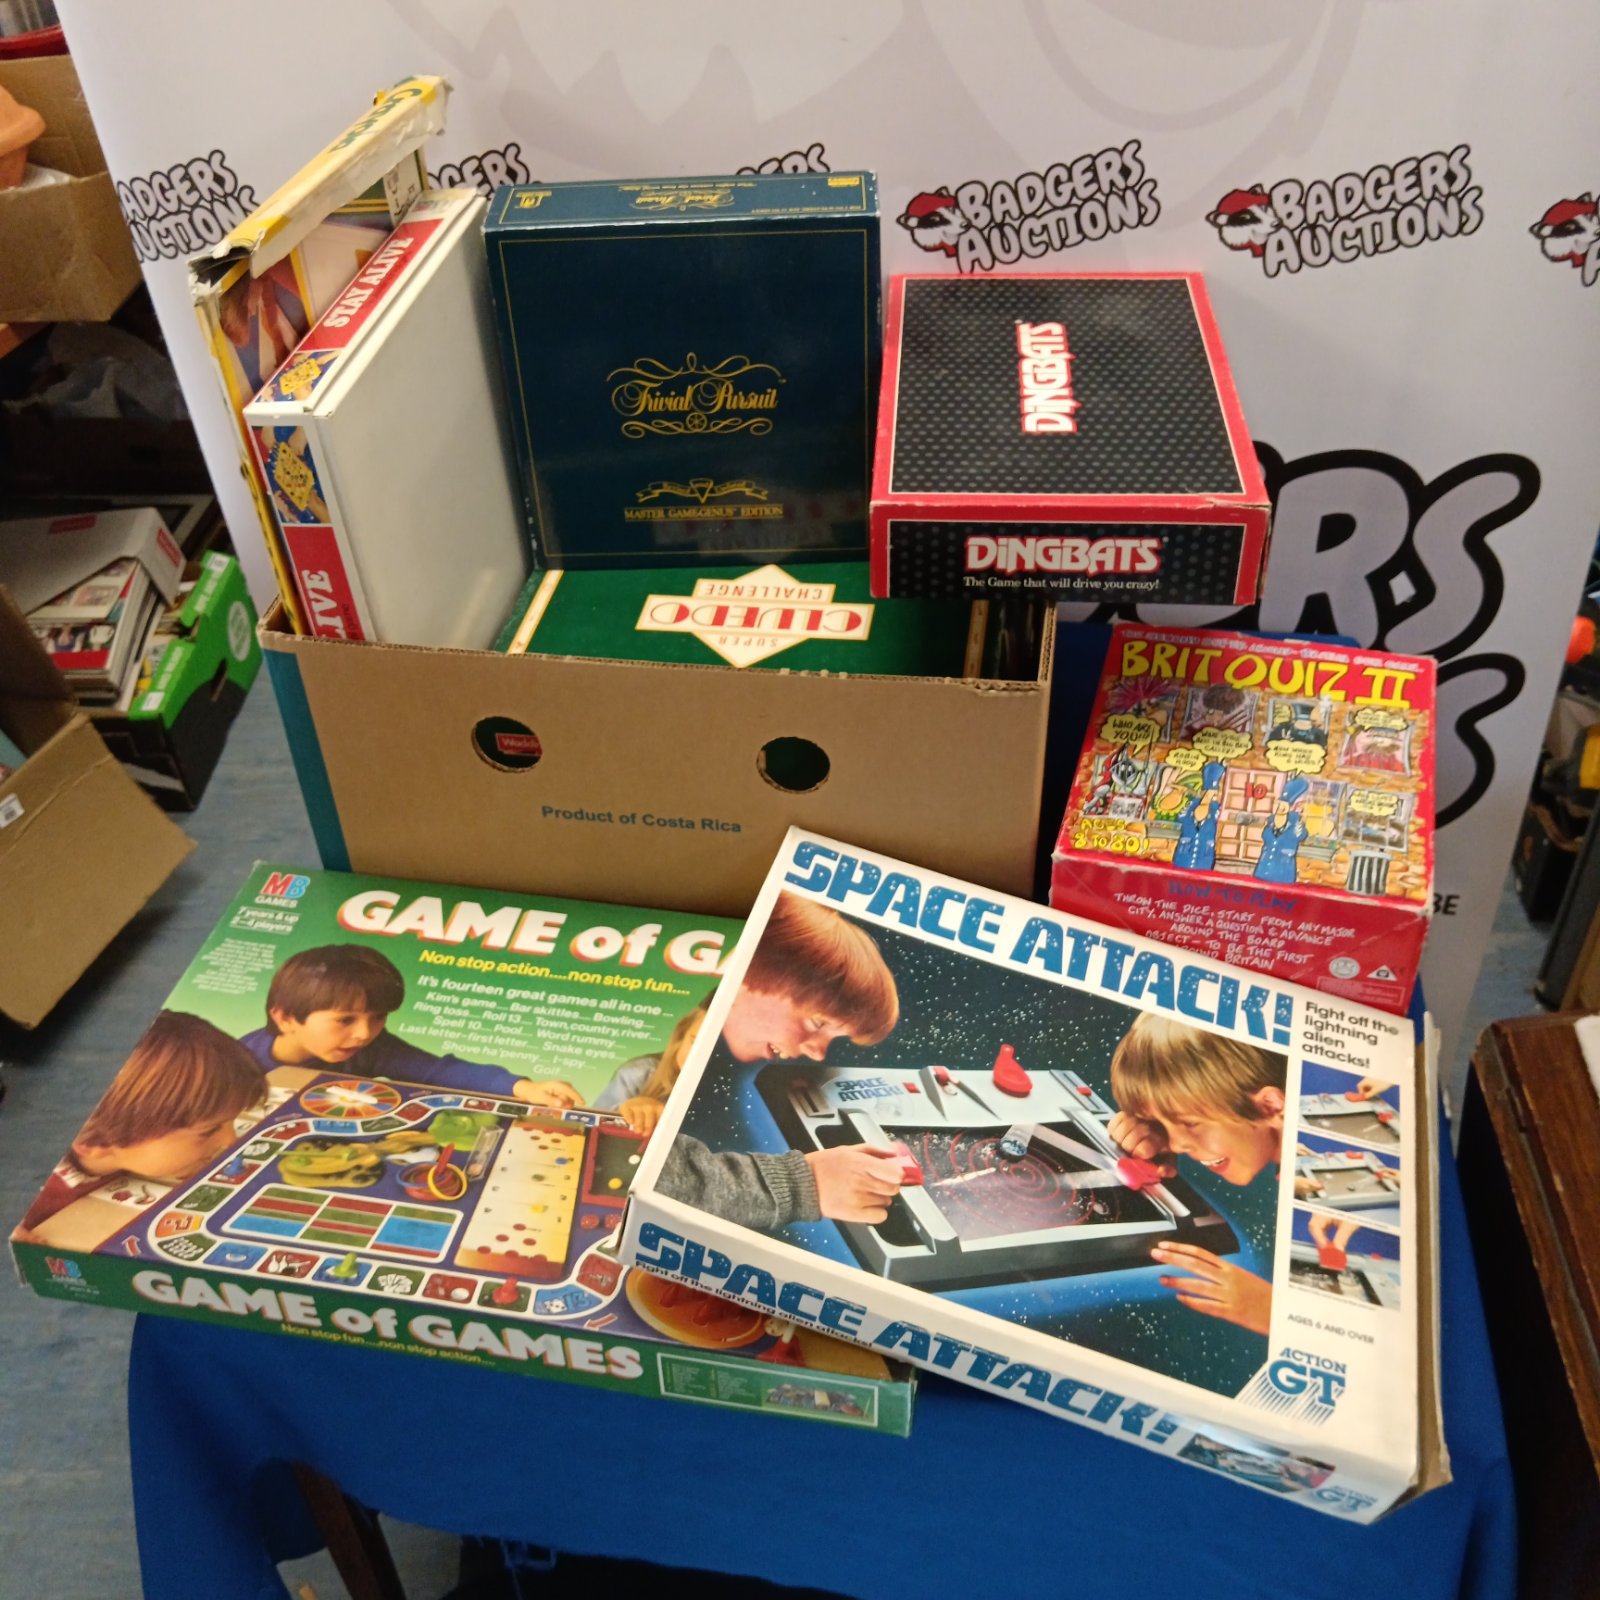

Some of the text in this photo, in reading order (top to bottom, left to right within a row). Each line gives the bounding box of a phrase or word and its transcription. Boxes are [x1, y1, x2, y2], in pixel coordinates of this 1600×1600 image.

[117, 149, 238, 222] ADGERS
[427, 142, 531, 201] GERS
[954, 139, 1145, 231] BADGERS
[1269, 143, 1472, 231] BADGERS
[956, 178, 1161, 274] AUCTIONS
[1262, 185, 1484, 278] AUCTIONS
[322, 236, 414, 328] STAY ALIVE
[611, 377, 779, 416] Trivial Pursuit
[741, 506, 784, 518] EDITION
[705, 584, 822, 601] CHALLENGE
[963, 576, 1160, 591] The Game that will drive you crazy!
[302, 569, 346, 640] IVE
[650, 602, 863, 634] CLUEDO
[719, 636, 779, 648] SUPER
[1121, 640, 1223, 683] BRIT
[1223, 654, 1349, 703] QUIZ
[1354, 668, 1416, 710] II
[1113, 718, 1134, 730] WHO
[541, 805, 742, 833] Product of Costa Rica
[1074, 831, 1088, 849] 8
[1091, 833, 1108, 848] TO
[259, 871, 311, 898] MB
[1168, 879, 1211, 898] HOW
[1251, 892, 1297, 914] PLAY
[245, 909, 275, 919] years
[284, 914, 301, 924] up
[254, 894, 299, 909] GAMES
[1113, 892, 1152, 906] THROW
[1154, 898, 1179, 911] THE
[1217, 909, 1256, 922] START
[1260, 916, 1294, 929] FROM
[1297, 922, 1321, 933] ANY
[1321, 925, 1357, 938] MAJOR
[336, 889, 569, 958] GAME
[568, 923, 663, 968] of
[784, 840, 1294, 1047] SPACE ATTACK!
[1159, 910, 1204, 925] ANSWER
[1205, 917, 1215, 927] A
[1216, 918, 1265, 935] QUESTION
[1268, 926, 1278, 936] &
[1279, 928, 1334, 947] ADVANCE
[1170, 923, 1287, 949] AROUND THE BOARD
[1145, 929, 1314, 965] OBJECT TO BE THE FIRST
[1224, 952, 1276, 970] BRITAIN
[418, 948, 456, 967] Non
[456, 955, 496, 973] stop
[603, 973, 643, 991] stop
[413, 1001, 443, 1016] Ring
[482, 1010, 508, 1024] Roll
[441, 977, 505, 996] fourteen
[506, 987, 546, 1001] great
[547, 991, 598, 1008] games
[598, 998, 618, 1011] all
[618, 1000, 632, 1012] in
[633, 1002, 663, 1016] one
[509, 1002, 533, 1014] Bar
[432, 1015, 467, 1030] Spell
[536, 1028, 572, 1041] Word
[1304, 1014, 1379, 1047] lightning
[1305, 1000, 1400, 1036] Fight off the
[398, 1022, 427, 1036] Last
[542, 1040, 584, 1055] Snake
[441, 1039, 482, 1055] Shove
[1302, 1029, 1346, 1050] alien
[1301, 1042, 1371, 1069] attacks!
[834, 1076, 889, 1091] SPACE
[635, 1259, 873, 1350] Fight off the lightning alien attacks!
[132, 1269, 323, 1329] GAME
[330, 1308, 399, 1339] of
[406, 1313, 646, 1381] GAMES
[281, 1323, 311, 1336] Non
[311, 1329, 343, 1342] stop
[406, 1343, 438, 1358] stop
[634, 1220, 1181, 1445] SPACE ATTACK!
[1287, 1313, 1375, 1344] AGES 6 AND OVER
[1279, 1346, 1348, 1375] ACTION
[1268, 1359, 1347, 1408] GT
[1312, 1486, 1374, 1514] GT
